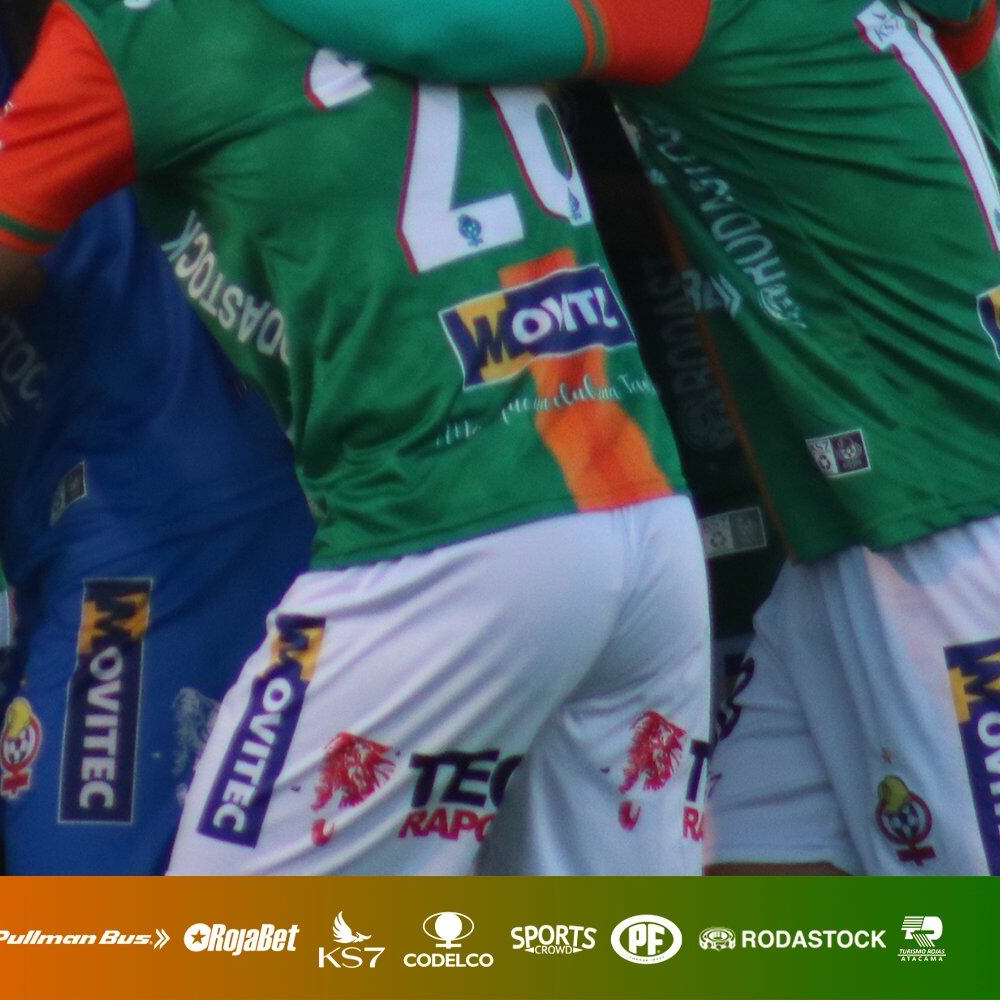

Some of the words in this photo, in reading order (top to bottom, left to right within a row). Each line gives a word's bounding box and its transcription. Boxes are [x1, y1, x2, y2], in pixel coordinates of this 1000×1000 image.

[160, 209, 290, 366] DASTOCK
[79, 582, 148, 810] MOVITEC
[398, 807, 497, 843] RAP
